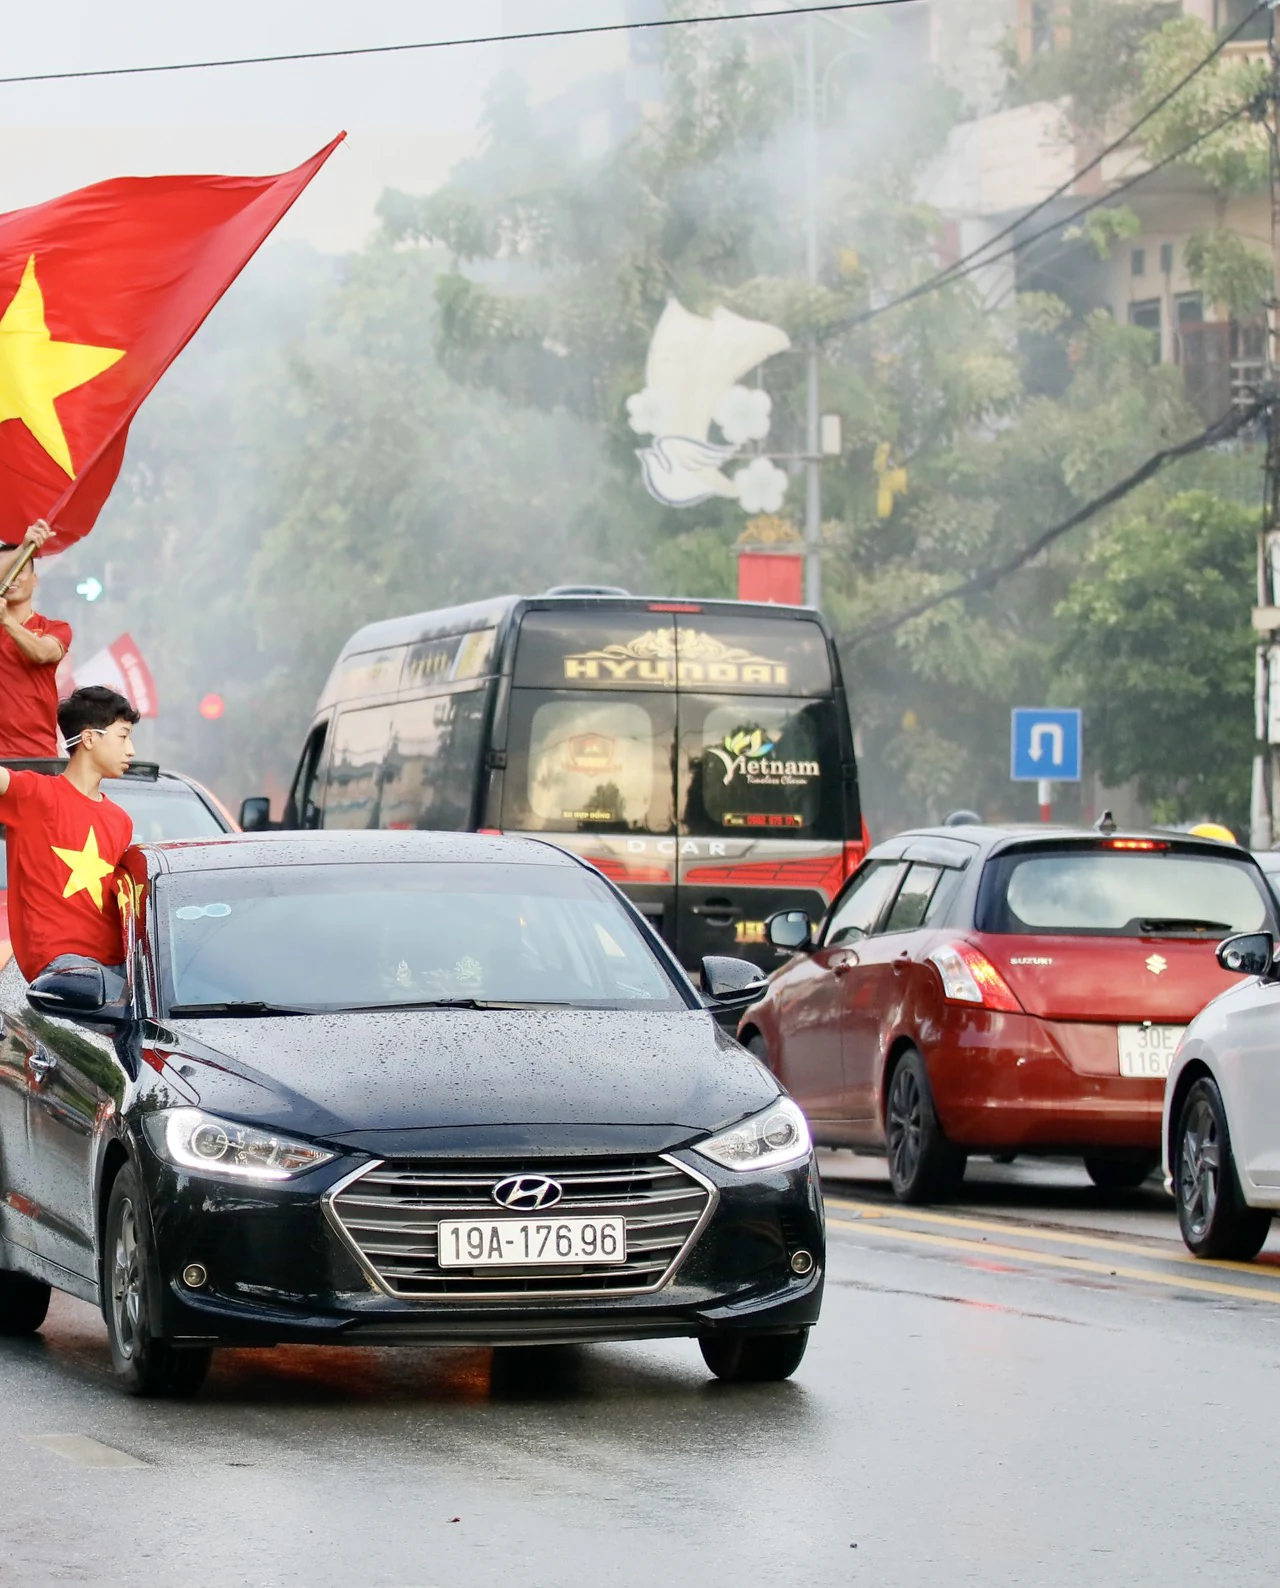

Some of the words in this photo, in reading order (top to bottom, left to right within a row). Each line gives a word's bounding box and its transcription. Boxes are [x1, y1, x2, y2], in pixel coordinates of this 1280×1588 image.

[564, 658, 788, 685] HYUNDAI
[707, 748, 821, 786] Vietnam
[1010, 957, 1053, 965] SUZUKI
[1138, 1027, 1174, 1050] 30E
[450, 1223, 617, 1260] 19A-176.96
